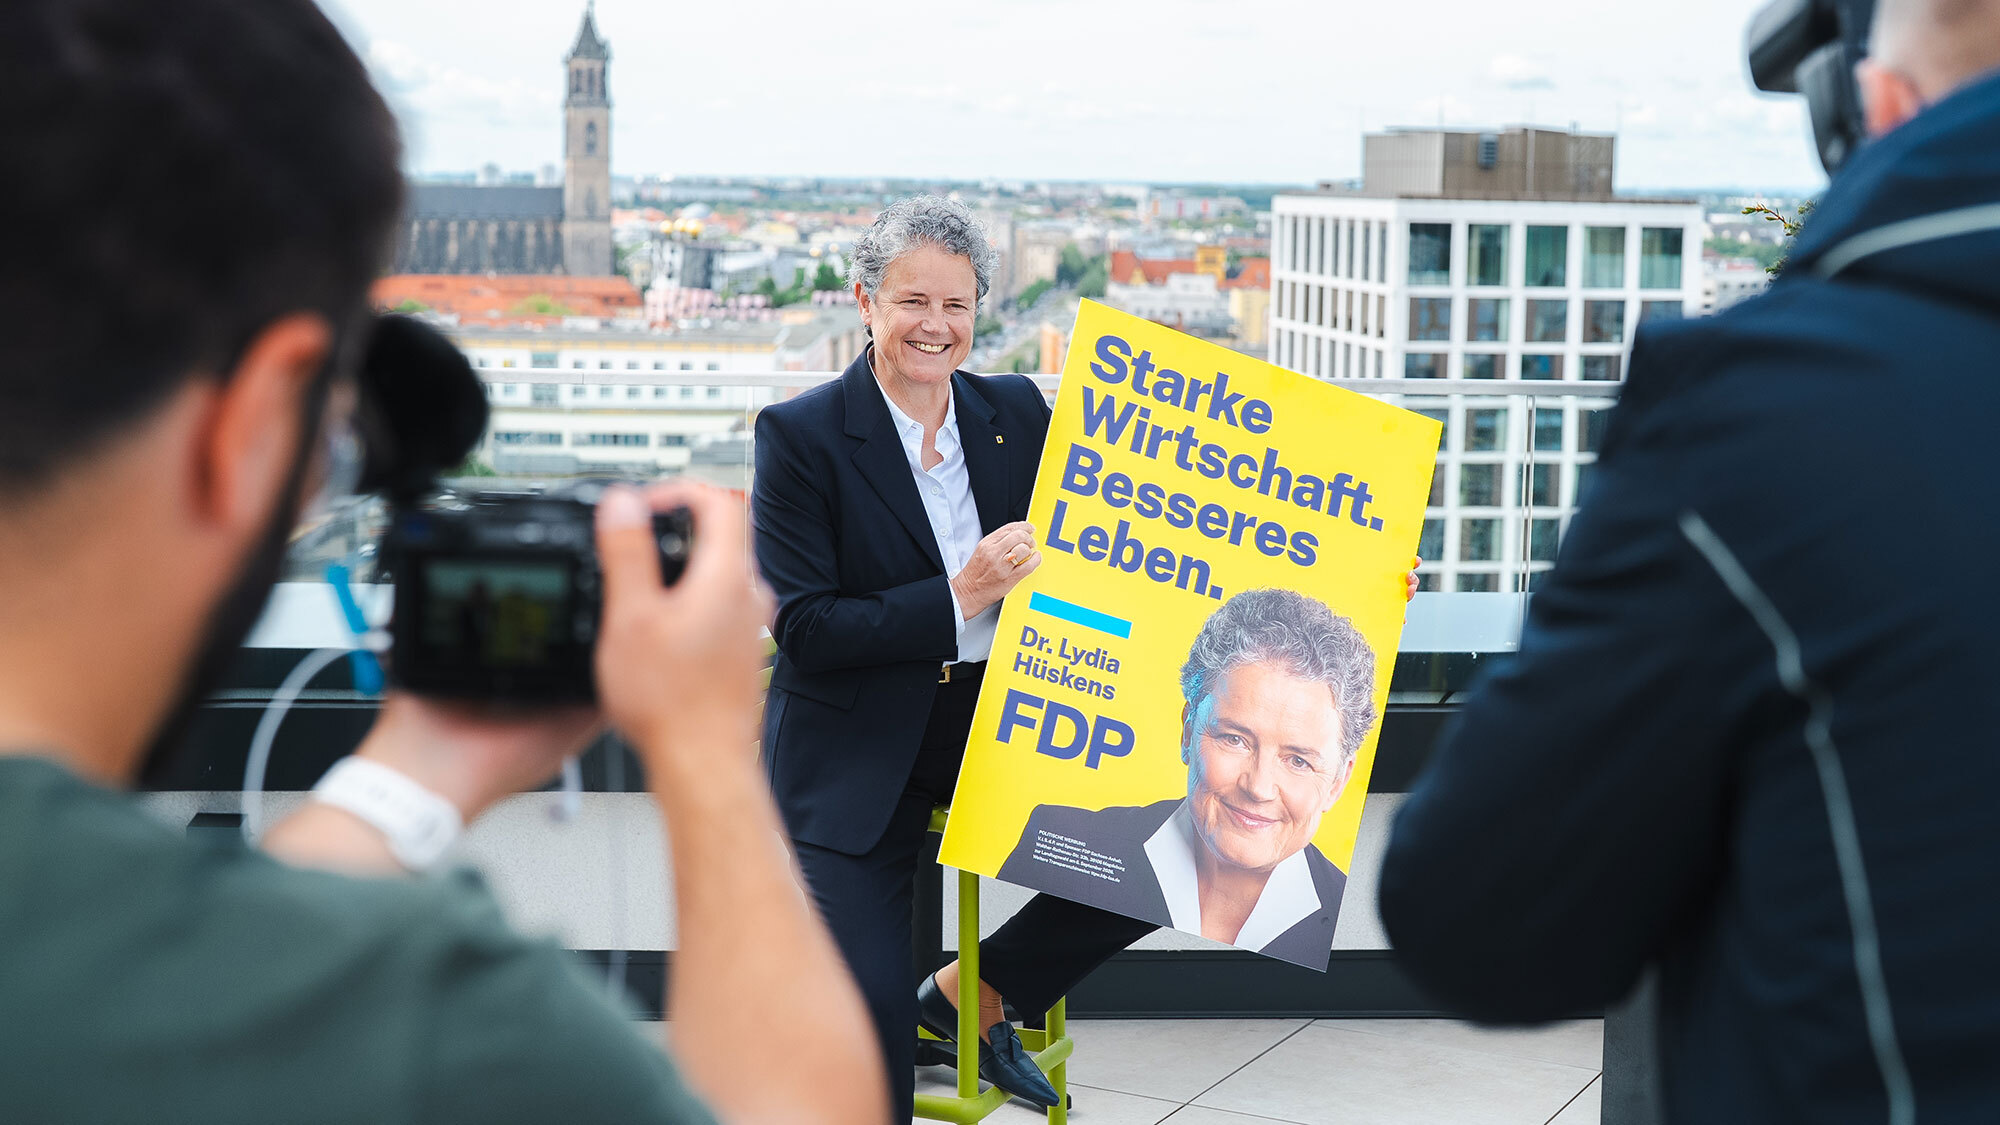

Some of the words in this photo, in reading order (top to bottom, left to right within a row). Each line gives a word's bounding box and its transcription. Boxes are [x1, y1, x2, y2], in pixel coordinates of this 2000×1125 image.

[1090, 335, 1272, 434] Starke
[1081, 386, 1384, 531] Wirtschaft.
[1061, 443, 1319, 567] Besseres
[1046, 500, 1223, 601] Leben.
[1013, 651, 1115, 700] Hüskens
[1019, 626, 1054, 655] Dr.
[1059, 638, 1120, 674] Lydia
[996, 688, 1135, 770] FDP
[1038, 830, 1064, 841] POLITISCHE
[1064, 837, 1086, 847] WERBUNG
